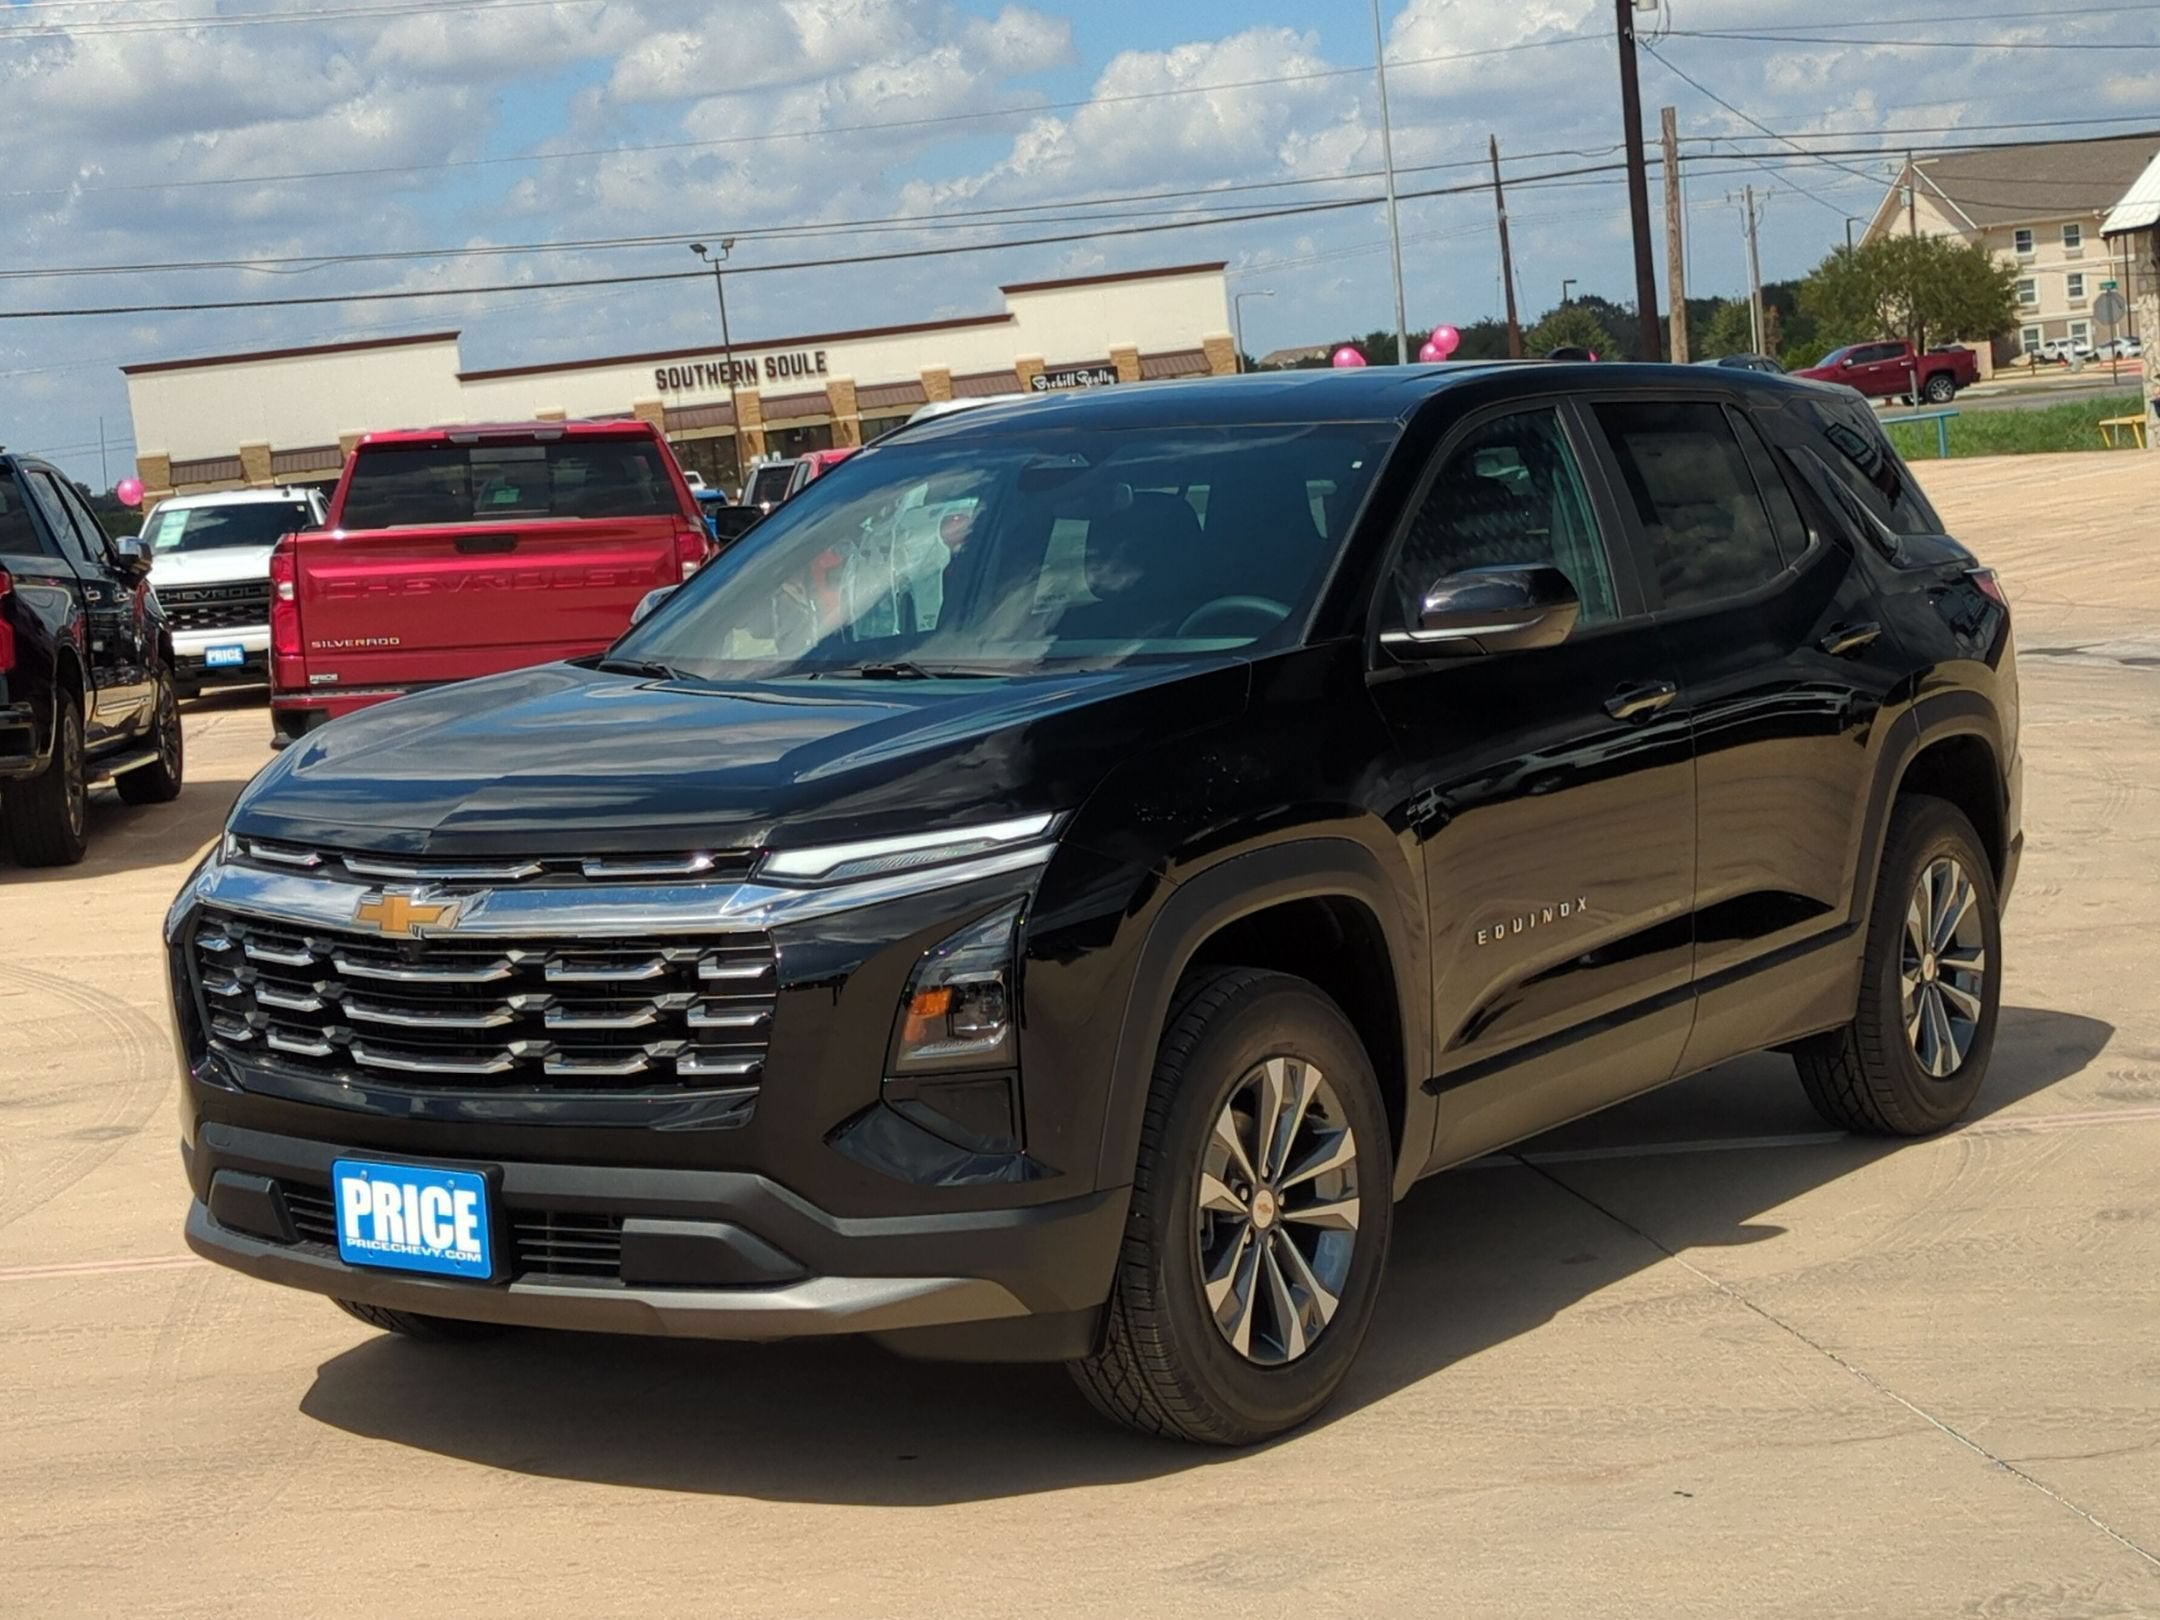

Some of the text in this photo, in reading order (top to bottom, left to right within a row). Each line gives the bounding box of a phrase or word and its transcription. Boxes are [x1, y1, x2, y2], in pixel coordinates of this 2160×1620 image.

[655, 351, 827, 390] SOUTHERN SOULE
[312, 637, 400, 648] SILVERADO
[1477, 897, 1586, 945] EQUINOX
[341, 1177, 482, 1253] PRICE
[346, 1238, 482, 1263] PRICECHEVY.COM
